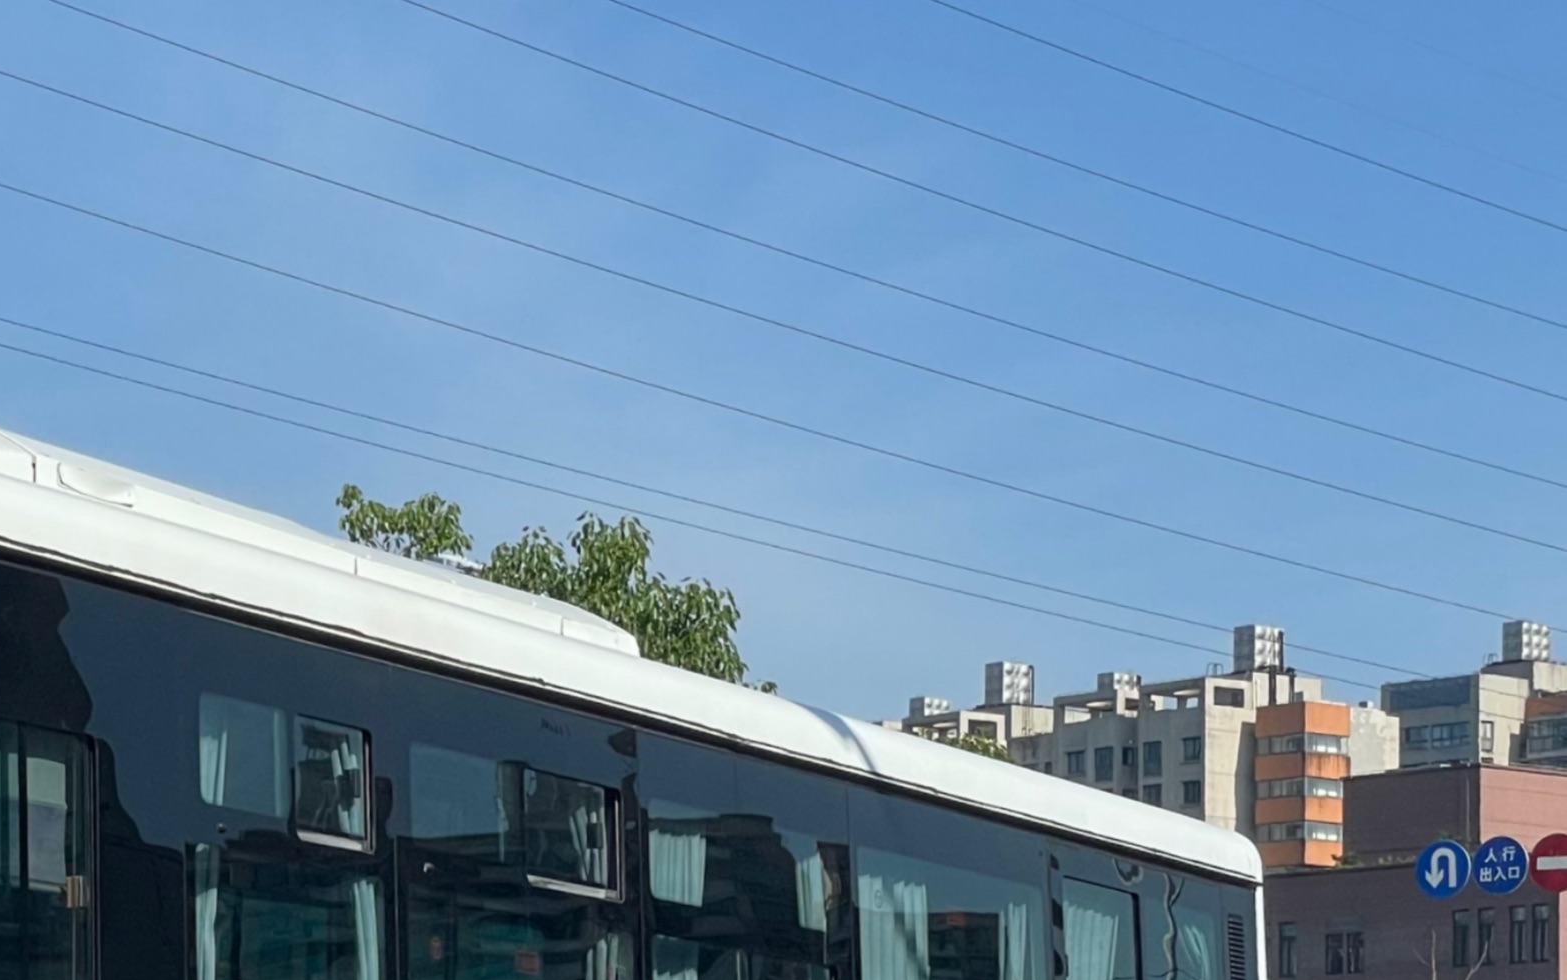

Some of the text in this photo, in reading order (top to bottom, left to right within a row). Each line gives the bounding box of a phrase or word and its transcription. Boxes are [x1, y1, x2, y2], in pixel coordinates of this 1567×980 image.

[1484, 845, 1516, 863] 人行
[1479, 866, 1521, 883] 出入口
